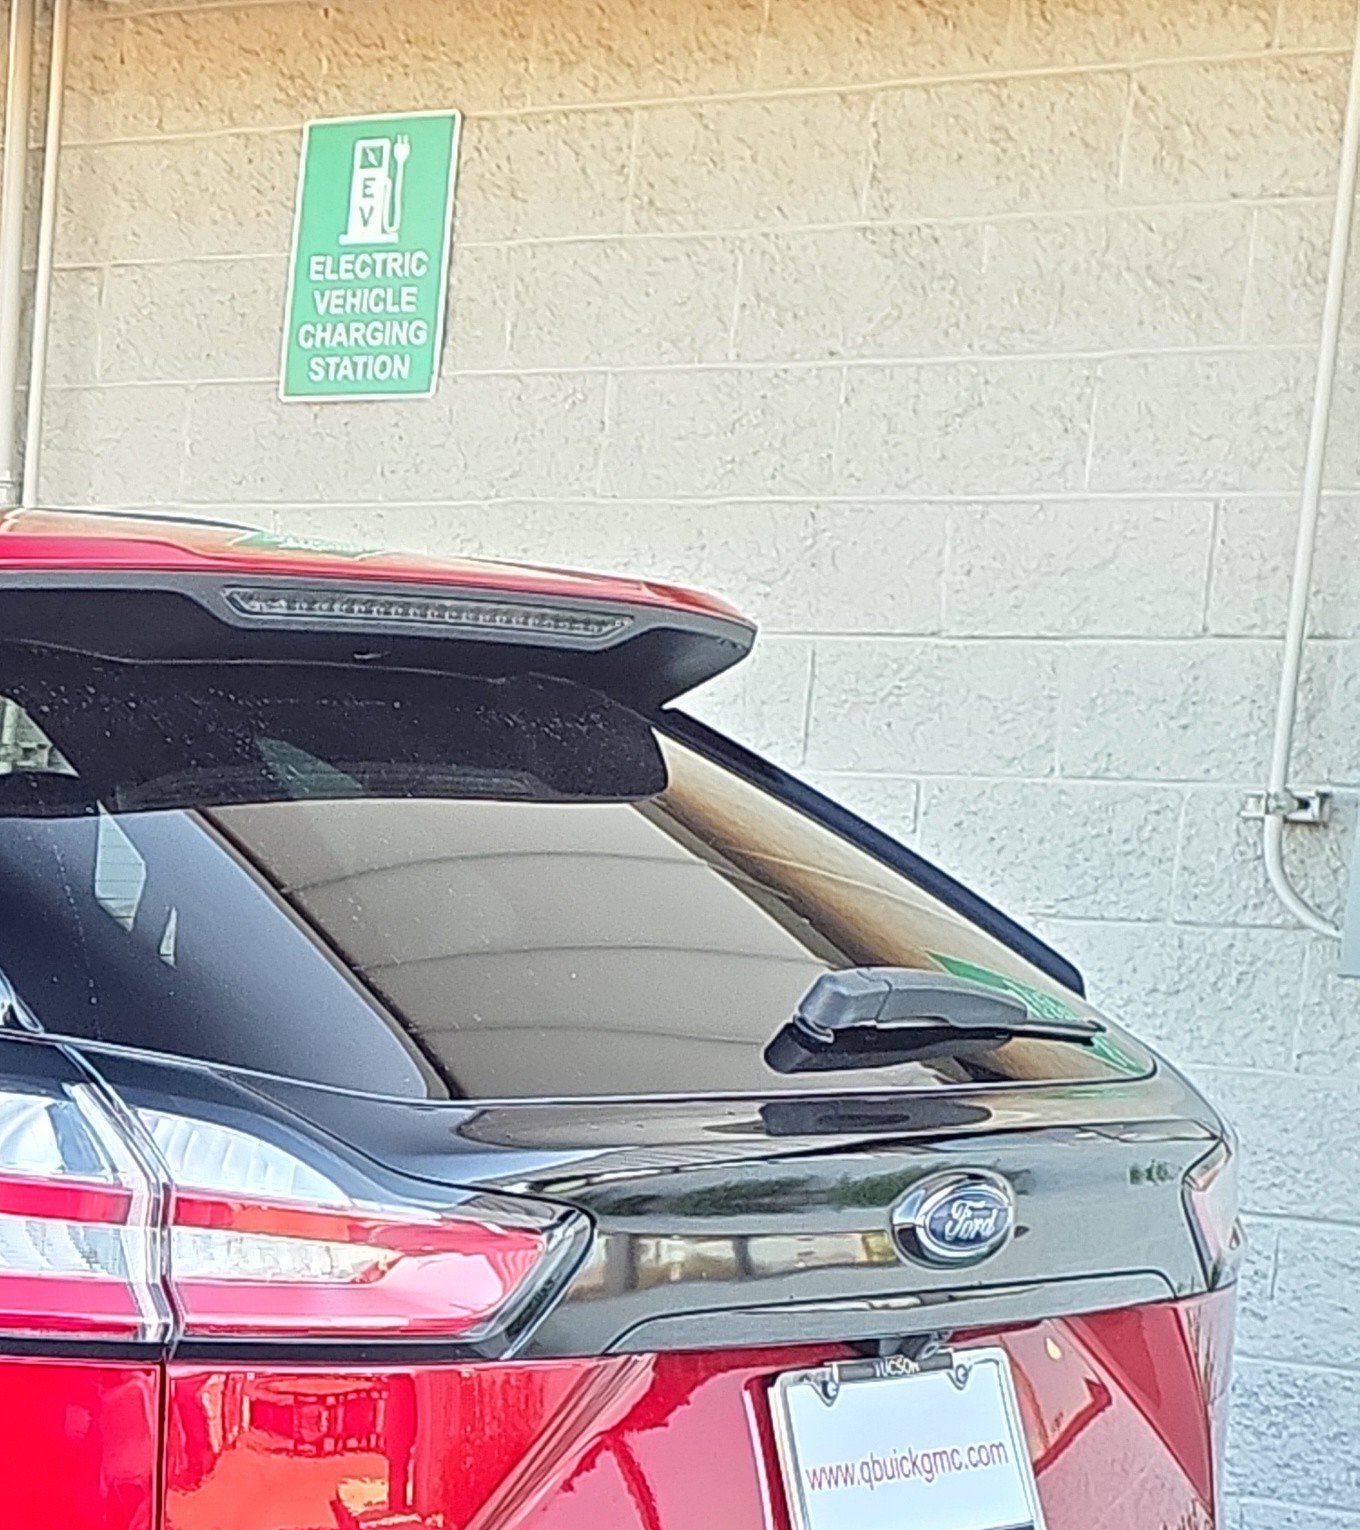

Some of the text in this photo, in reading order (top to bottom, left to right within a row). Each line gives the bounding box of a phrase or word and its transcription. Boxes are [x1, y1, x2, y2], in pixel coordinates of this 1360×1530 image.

[308, 251, 429, 281] ELECTRIC
[313, 286, 418, 315] VEHICLE
[298, 319, 428, 348] CHARGING
[308, 354, 411, 382] STATION
[944, 1200, 998, 1242] Ford
[805, 1440, 1010, 1491] www.qbuickgmc.com
